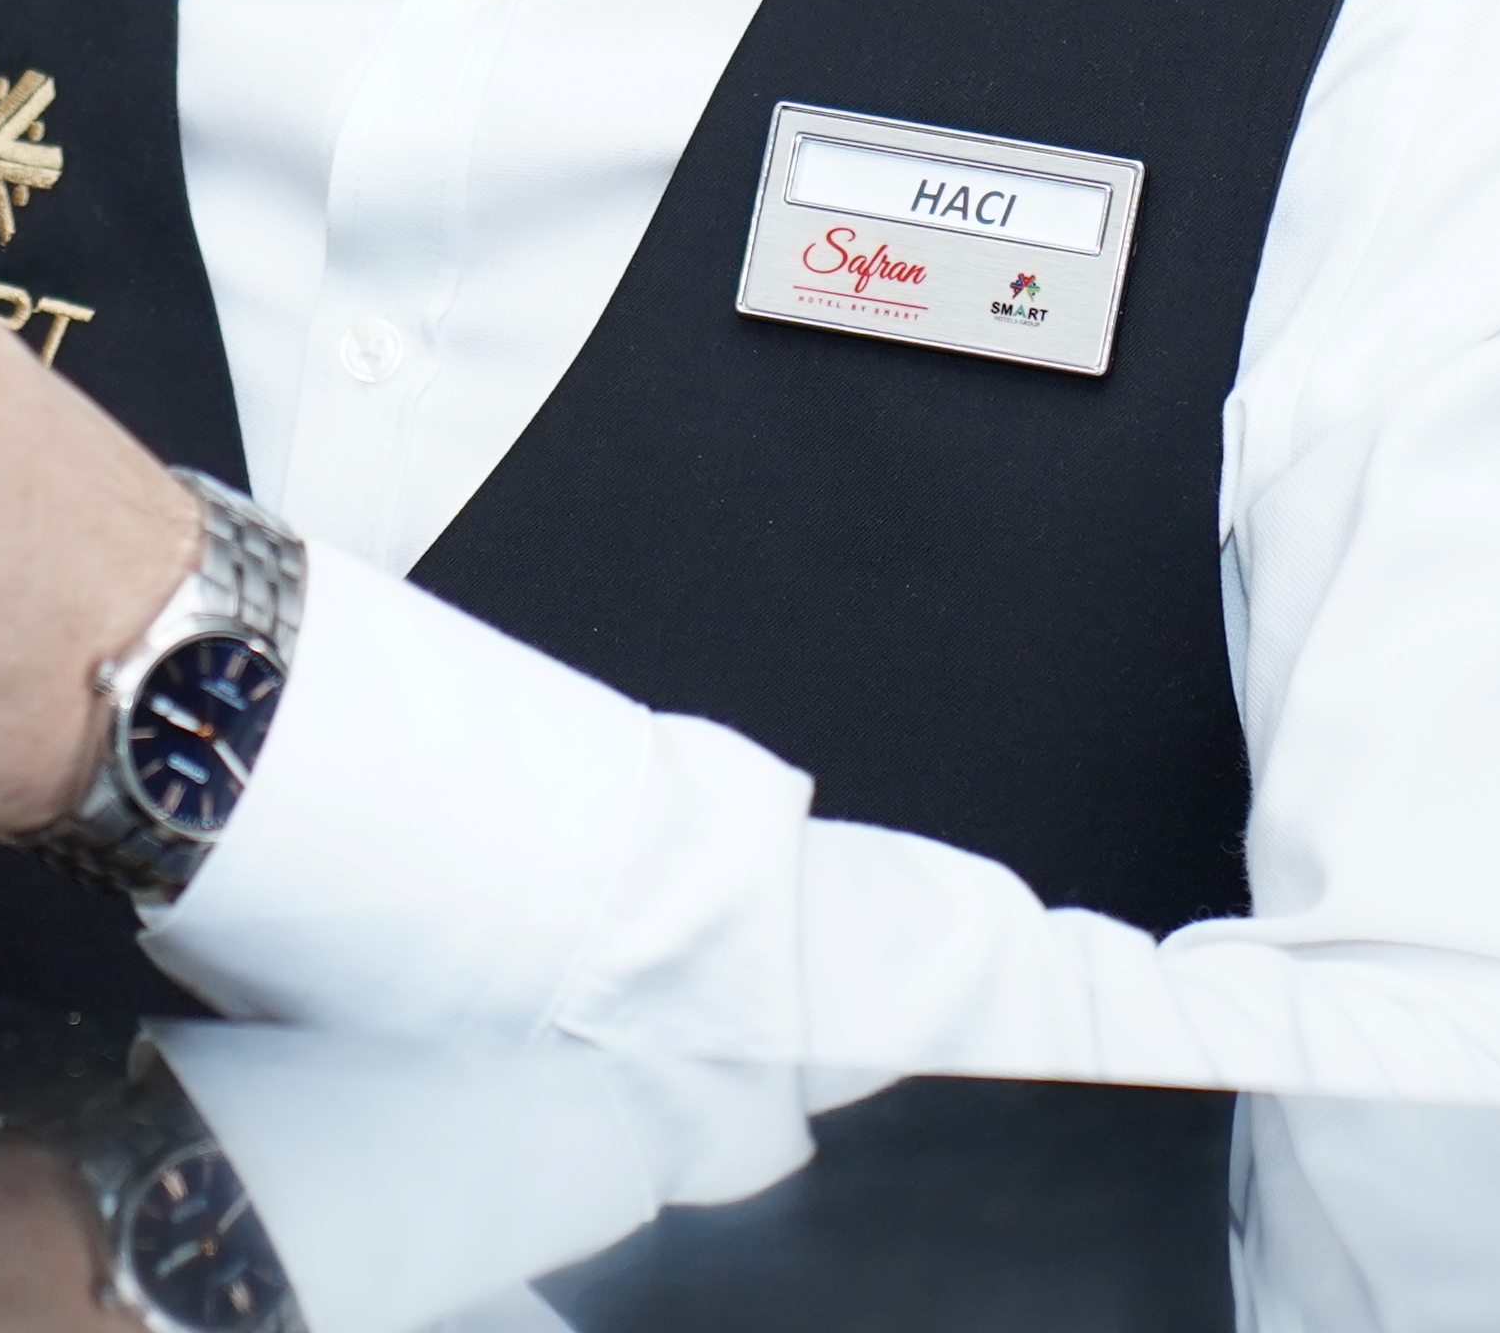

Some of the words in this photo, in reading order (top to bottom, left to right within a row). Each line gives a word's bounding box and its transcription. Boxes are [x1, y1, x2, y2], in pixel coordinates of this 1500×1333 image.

[910, 179, 1018, 227] HACI
[802, 227, 927, 294] Safran
[798, 295, 842, 309] HOTEL
[851, 304, 866, 312] BY
[874, 308, 919, 321] SMART
[990, 301, 1049, 322] SMART
